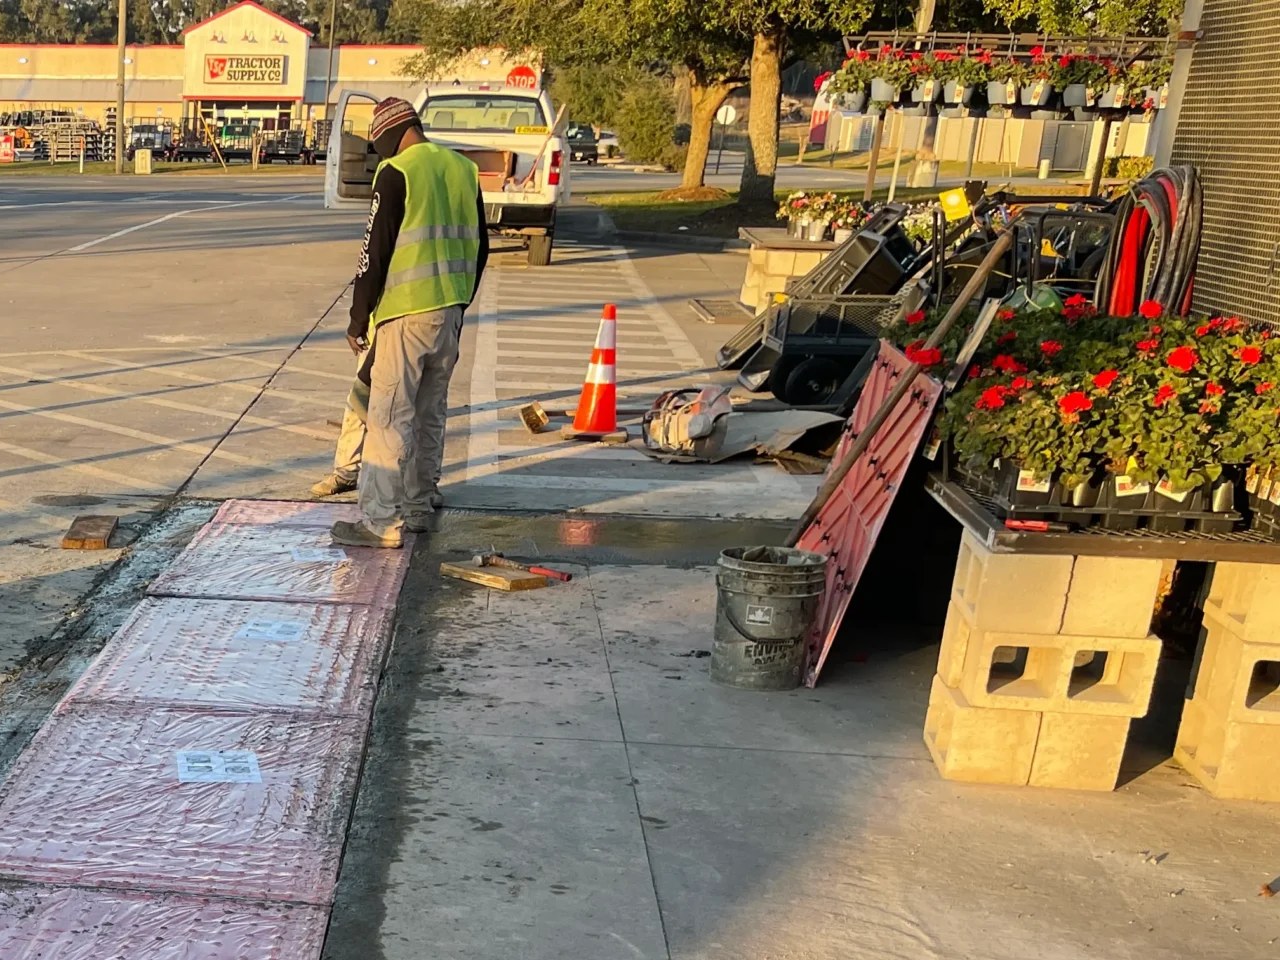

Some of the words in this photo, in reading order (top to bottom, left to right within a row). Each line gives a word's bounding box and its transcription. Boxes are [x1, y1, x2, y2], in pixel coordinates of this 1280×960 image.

[227, 57, 281, 69] TRACTOR
[227, 70, 267, 81] SUPPLY
[507, 75, 536, 88] STOP
